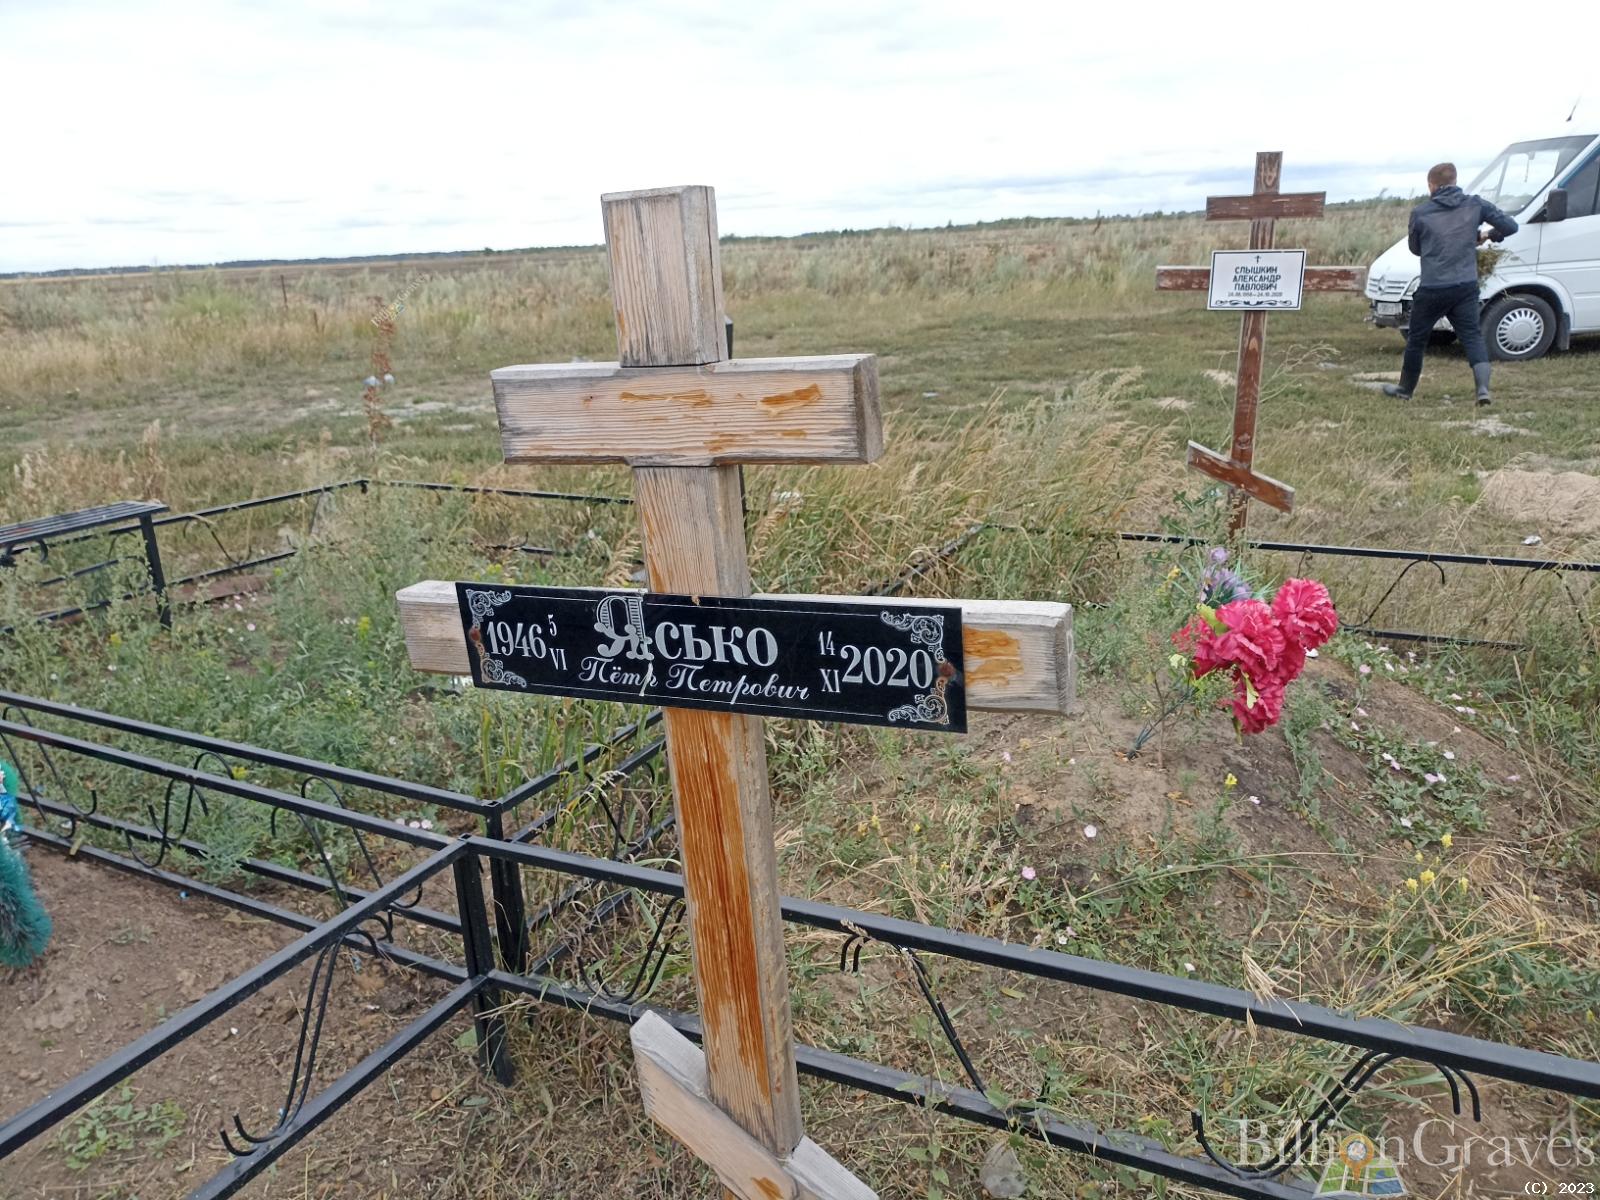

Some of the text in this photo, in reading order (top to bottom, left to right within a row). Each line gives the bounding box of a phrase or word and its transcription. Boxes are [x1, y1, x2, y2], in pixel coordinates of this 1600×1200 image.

[1232, 274, 1281, 283] АЛЕКСАНДР
[1234, 266, 1278, 274] СЛЫШКИН
[1234, 283, 1277, 291] ПАВЛОВИЧ
[547, 613, 557, 636] 5
[485, 620, 547, 659] 1946
[817, 631, 836, 656] 14
[550, 647, 568, 672] VI
[840, 644, 933, 689] 2020
[578, 656, 810, 705] Пётр Петрович
[821, 667, 841, 694] XI
